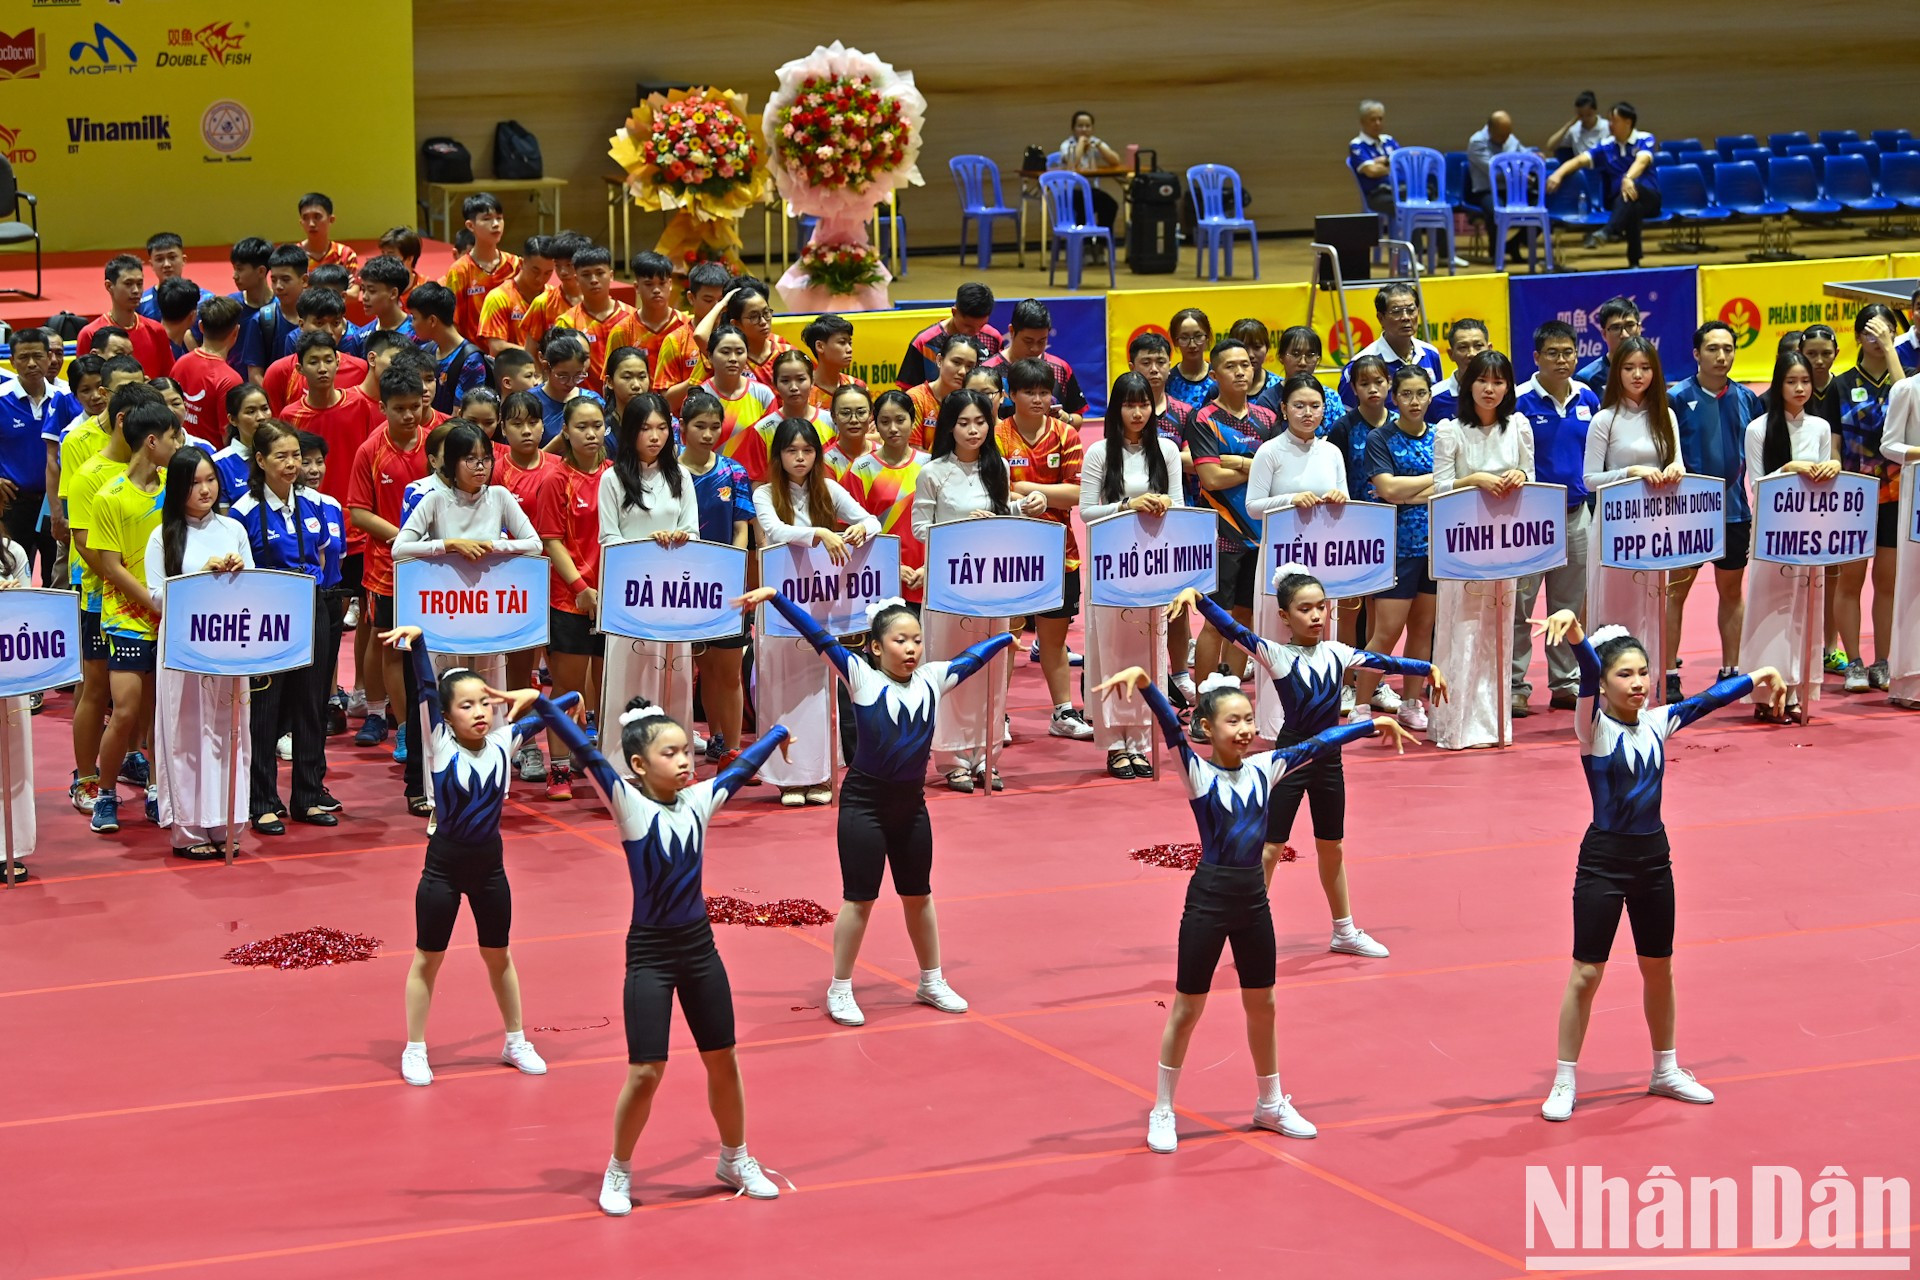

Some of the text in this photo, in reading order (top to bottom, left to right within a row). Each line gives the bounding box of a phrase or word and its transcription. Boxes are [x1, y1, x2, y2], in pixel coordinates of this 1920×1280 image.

[69, 64, 137, 75] MOFIT
[225, 53, 252, 65] FISH
[66, 115, 171, 142] Vinamilk
[68, 145, 79, 154] EST
[1768, 302, 1797, 325] PHÂN
[1801, 301, 1822, 323] BÓN
[1826, 299, 1839, 321] CÀ
[871, 360, 897, 384] BÓN
[1605, 490, 1721, 524] CLB ĐẠI HỌC BÌNH DƯƠNG
[1773, 487, 1864, 517] CÂU LẠC BỘ
[1274, 533, 1385, 568] TIỀN GIANG
[1445, 519, 1555, 553] VĨNH LONG
[1614, 527, 1714, 562] PPP CÀ MAU
[1765, 530, 1868, 555] TIMES CITY
[948, 552, 1045, 585] TÂY NINH
[1094, 542, 1213, 581] TP. HỒ CHÍ MINH
[418, 584, 528, 619] TRỌNG TÀI
[625, 571, 723, 609] ĐÀ NẴNG
[846, 566, 881, 603] ĐỘI
[0, 623, 66, 662] ĐỒNG
[190, 608, 291, 648] NGHỆ AN
